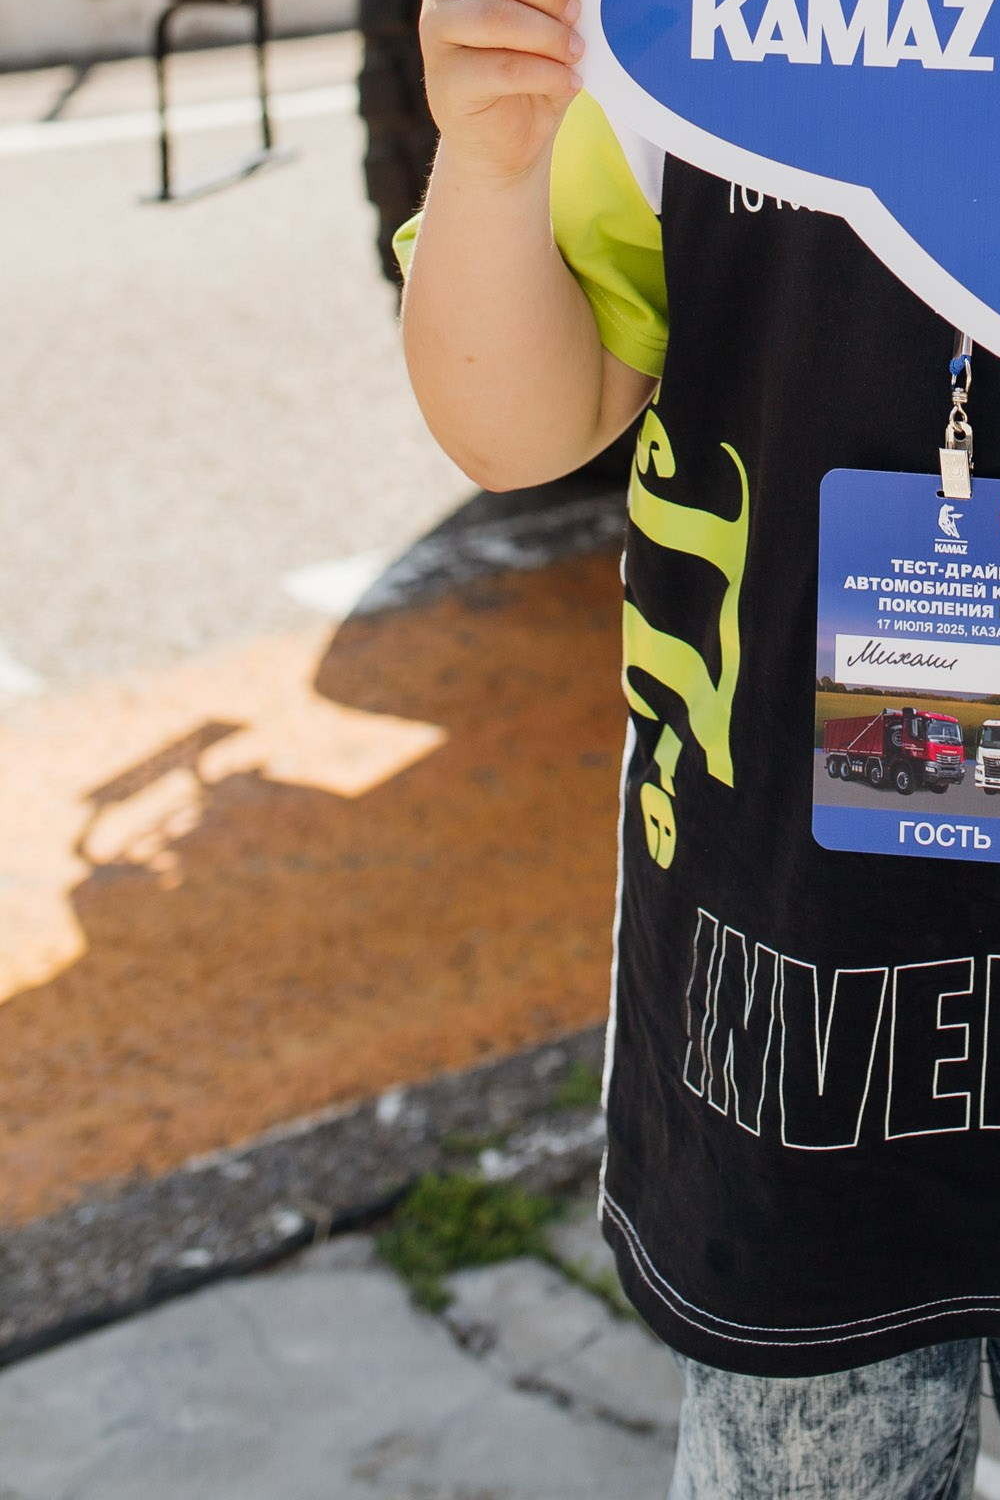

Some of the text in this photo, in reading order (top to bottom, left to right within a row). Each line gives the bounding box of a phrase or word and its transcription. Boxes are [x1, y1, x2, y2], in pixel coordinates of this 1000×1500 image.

[934, 543, 968, 555] KAMAZ
[843, 575, 987, 599] АВТОМОБИЛЕЙ
[878, 597, 994, 619] ПОКОЛЕНИЯ
[876, 619, 891, 630] 17
[894, 620, 933, 633] ИЮЛЯ
[936, 623, 968, 637] 2025,
[899, 820, 992, 849] ГОСТЬ
